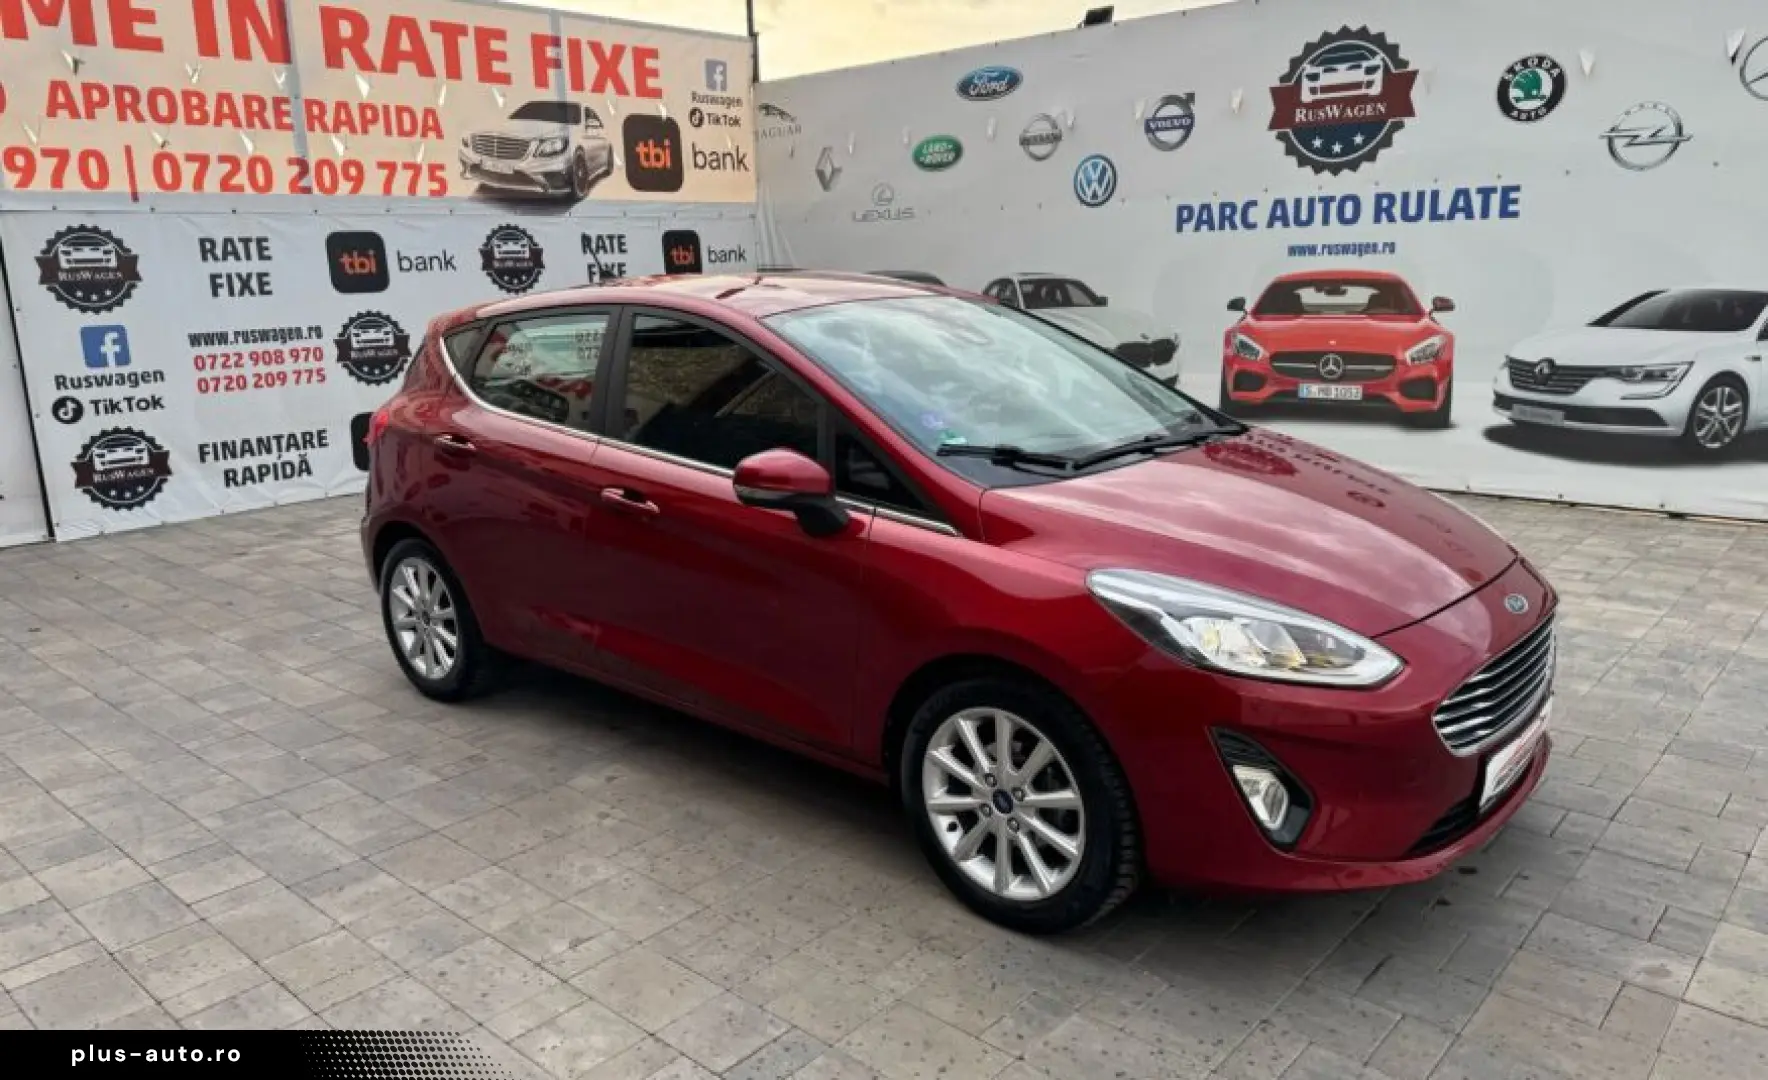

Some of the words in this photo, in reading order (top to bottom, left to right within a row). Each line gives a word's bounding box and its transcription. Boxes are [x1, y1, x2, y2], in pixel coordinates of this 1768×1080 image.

[191, 0, 292, 65] IN
[320, 6, 513, 86] RATE
[531, 32, 663, 100] FIXE
[46, 80, 294, 132] APROBARE
[303, 98, 445, 140] RAPIDA
[705, 112, 742, 128] TikTok
[1148, 117, 1191, 129] VOLVO
[636, 139, 671, 170] tbi
[692, 146, 750, 173] bank
[3, 146, 110, 191] 970
[152, 151, 274, 193] 0720
[286, 156, 366, 196] 209
[375, 160, 448, 198] 775
[852, 207, 916, 222] LEXUS
[1175, 199, 1259, 234] PARC
[1265, 192, 1363, 229] AUTO
[1372, 184, 1522, 225] RULATE
[198, 236, 272, 263] RATE
[581, 232, 629, 255] RATE
[708, 245, 747, 263] bank
[1286, 240, 1397, 258] www.ruswagen.ro
[339, 251, 376, 275] tbi
[397, 250, 457, 273] bank
[209, 272, 272, 298] FIXE
[188, 325, 323, 348] www.ruswagen.ro
[193, 352, 245, 372] 0722
[248, 348, 285, 367] 908
[289, 346, 324, 364] 970
[54, 369, 165, 391] Ruswagen
[197, 373, 247, 394] 0720
[252, 370, 288, 389] 209
[292, 367, 326, 386] 775
[89, 395, 165, 417] TikTok
